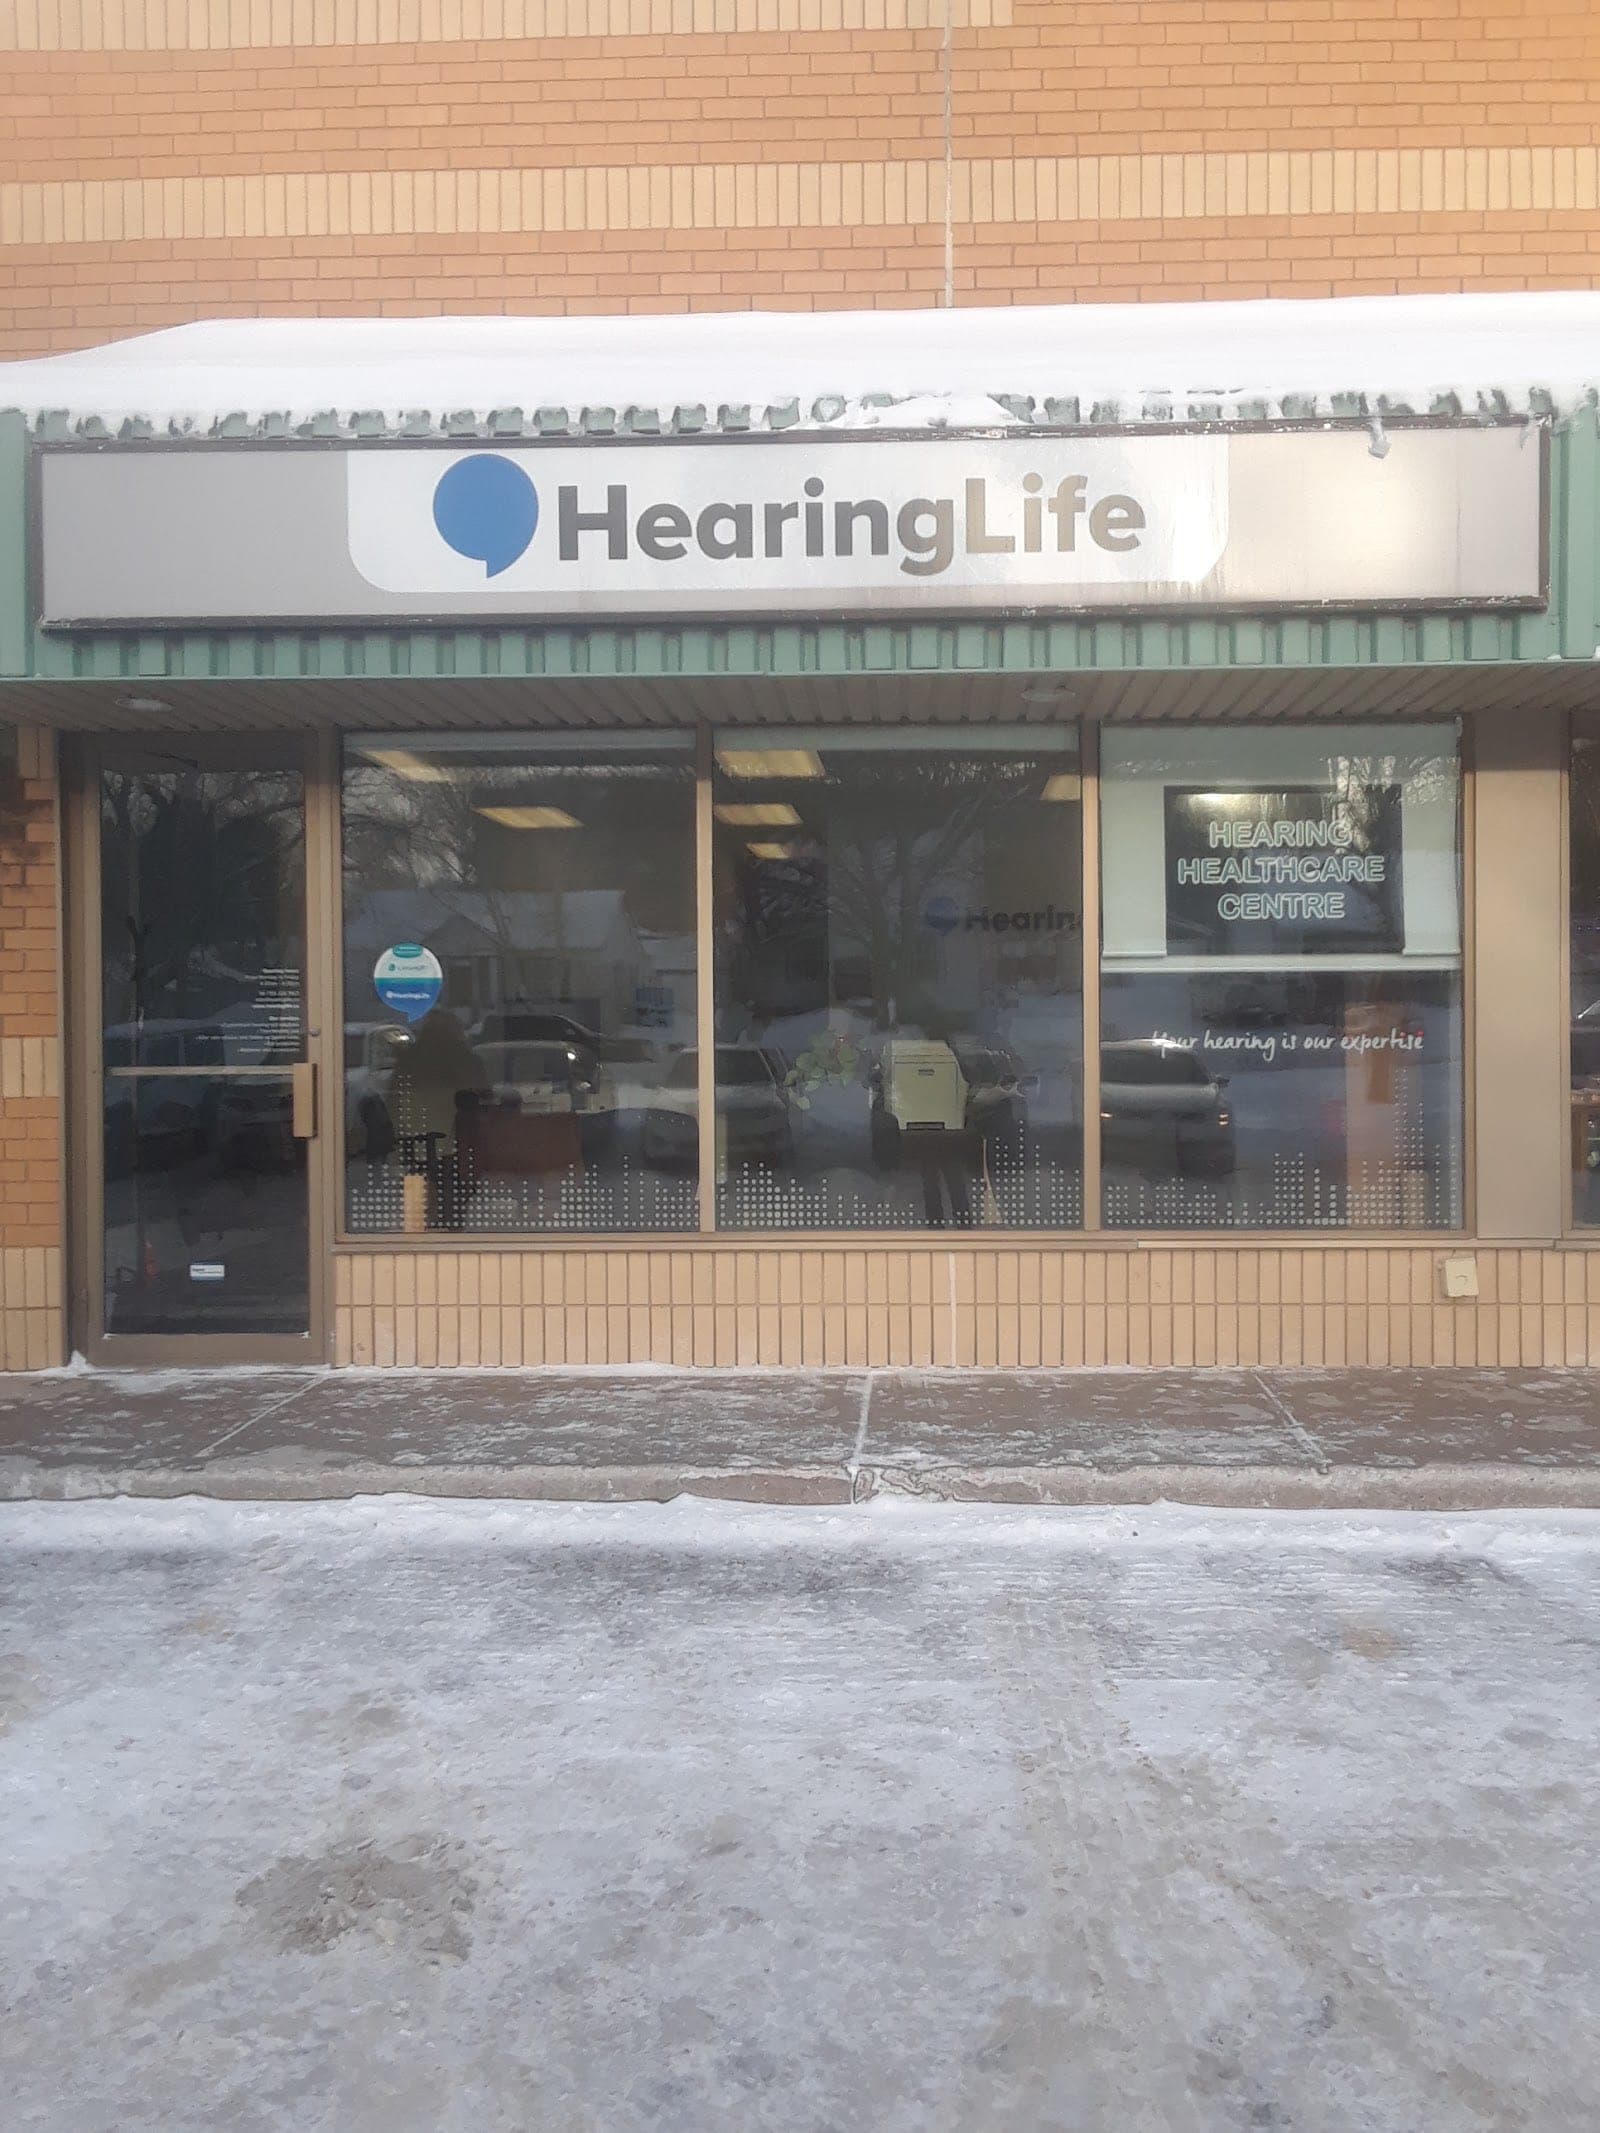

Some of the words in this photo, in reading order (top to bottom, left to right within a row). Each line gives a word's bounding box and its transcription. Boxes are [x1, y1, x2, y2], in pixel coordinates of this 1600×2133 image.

[558, 473, 1146, 577] HearingLife
[1209, 820, 1353, 849] HEARING
[1177, 855, 1386, 885] HEALTHCARE
[965, 904, 1082, 932] Hearin
[1217, 892, 1346, 921] CENTRE
[1152, 1030, 1198, 1058] Your
[1204, 1030, 1276, 1062] hearing
[1282, 1032, 1297, 1050] is
[1303, 1037, 1336, 1050] our
[1341, 1028, 1425, 1054] expertise
